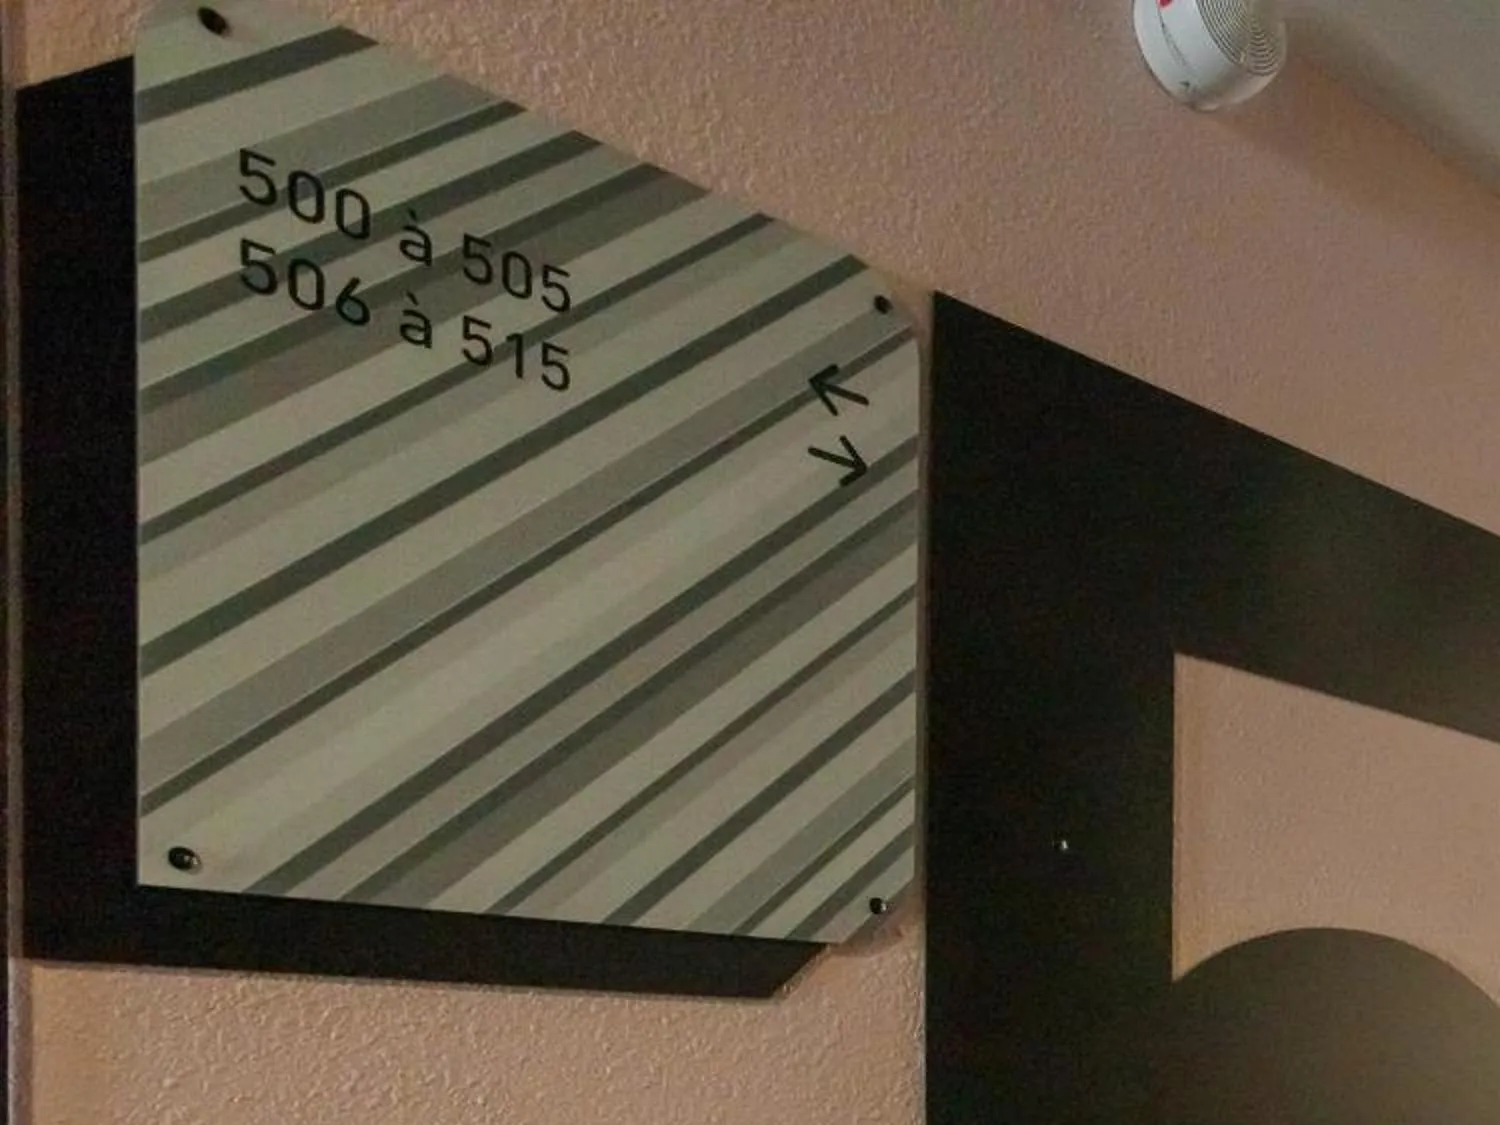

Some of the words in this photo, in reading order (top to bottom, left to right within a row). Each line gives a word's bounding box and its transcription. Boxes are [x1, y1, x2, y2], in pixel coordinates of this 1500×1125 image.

[239, 148, 371, 241] 500
[400, 210, 432, 266] à
[462, 234, 571, 313] 505
[239, 238, 371, 326] 506
[400, 293, 432, 349] à
[462, 315, 571, 391] 515
